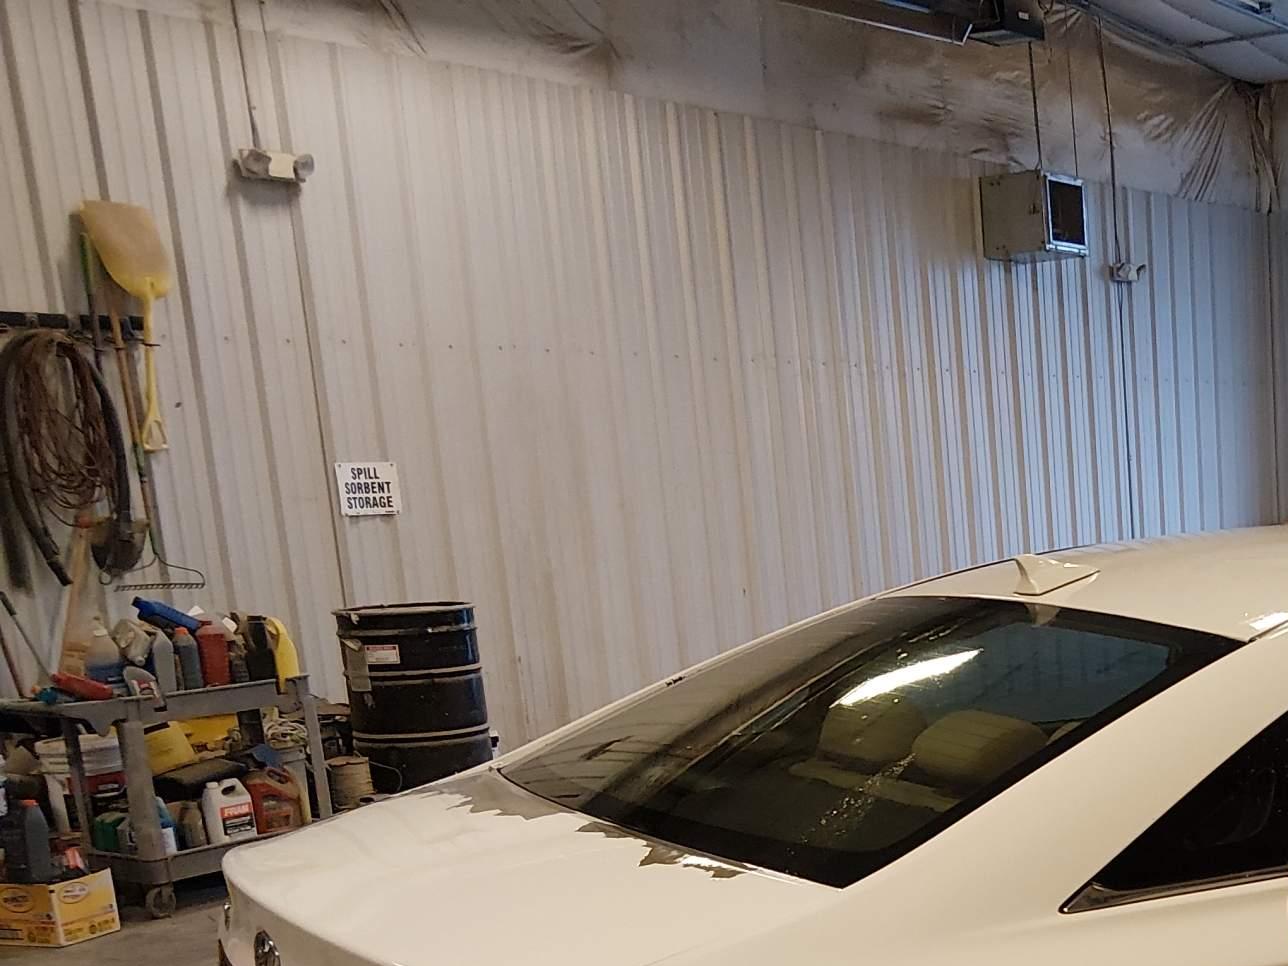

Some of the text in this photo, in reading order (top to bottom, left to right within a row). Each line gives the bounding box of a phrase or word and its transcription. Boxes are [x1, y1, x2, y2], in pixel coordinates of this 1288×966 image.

[351, 467, 380, 480] SPILL
[344, 482, 392, 495] SORBENT
[346, 495, 394, 509] STORAGE
